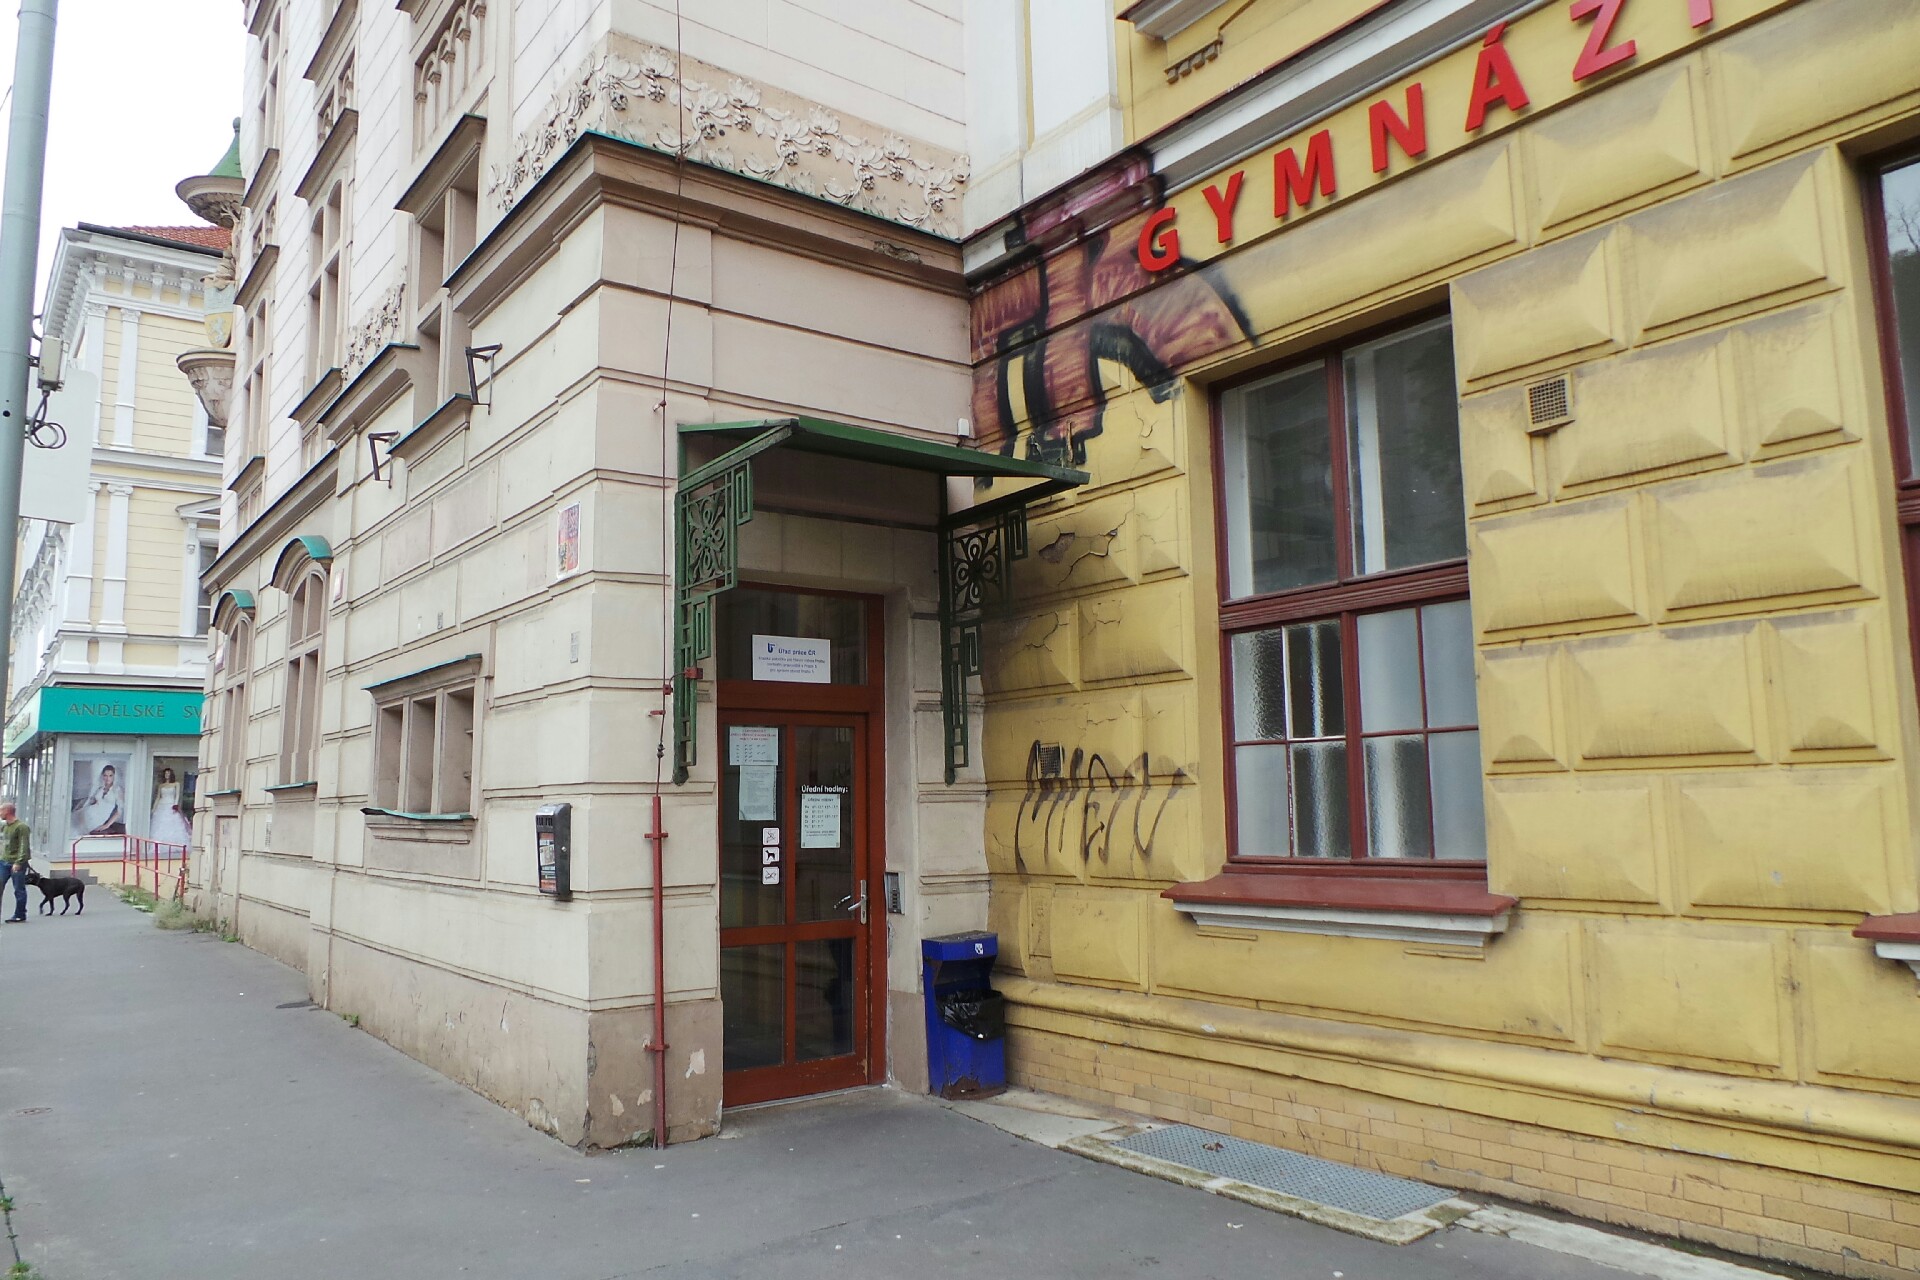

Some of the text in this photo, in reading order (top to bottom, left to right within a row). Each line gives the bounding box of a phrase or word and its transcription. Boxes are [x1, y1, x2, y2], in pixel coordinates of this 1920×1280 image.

[67, 701, 165, 718] ANDĚLSKÉ
[801, 784, 849, 794] Úřední hodiny:
